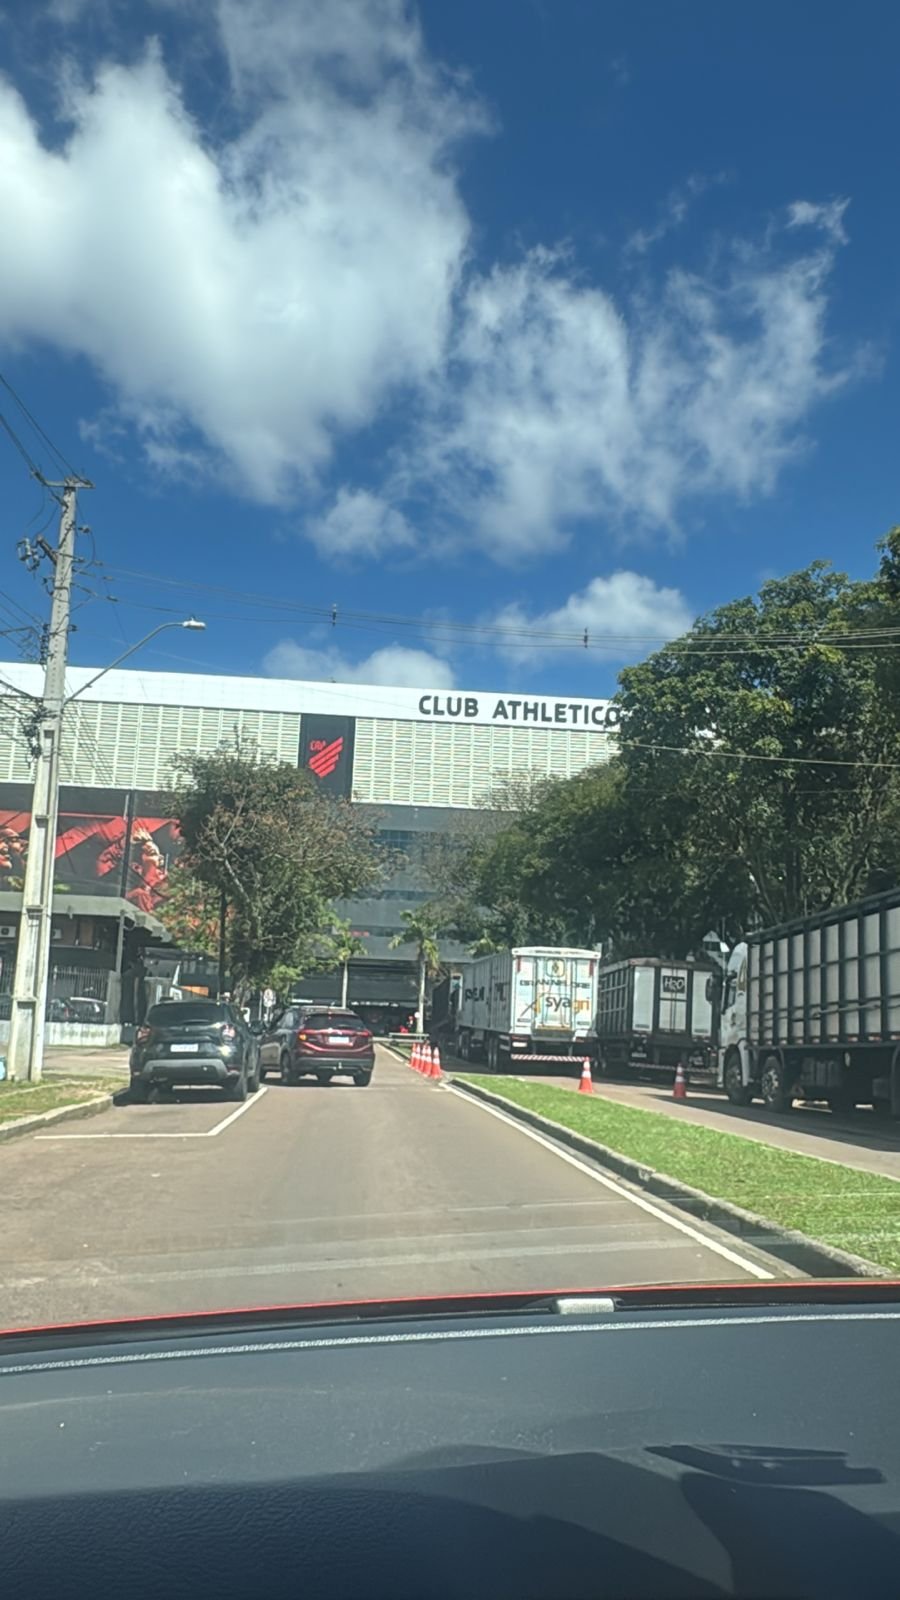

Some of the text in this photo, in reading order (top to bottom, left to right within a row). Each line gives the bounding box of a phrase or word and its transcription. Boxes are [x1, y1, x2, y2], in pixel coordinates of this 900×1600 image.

[419, 695, 622, 727] CLUB ATHLETICO
[545, 995, 590, 1014] syagri
